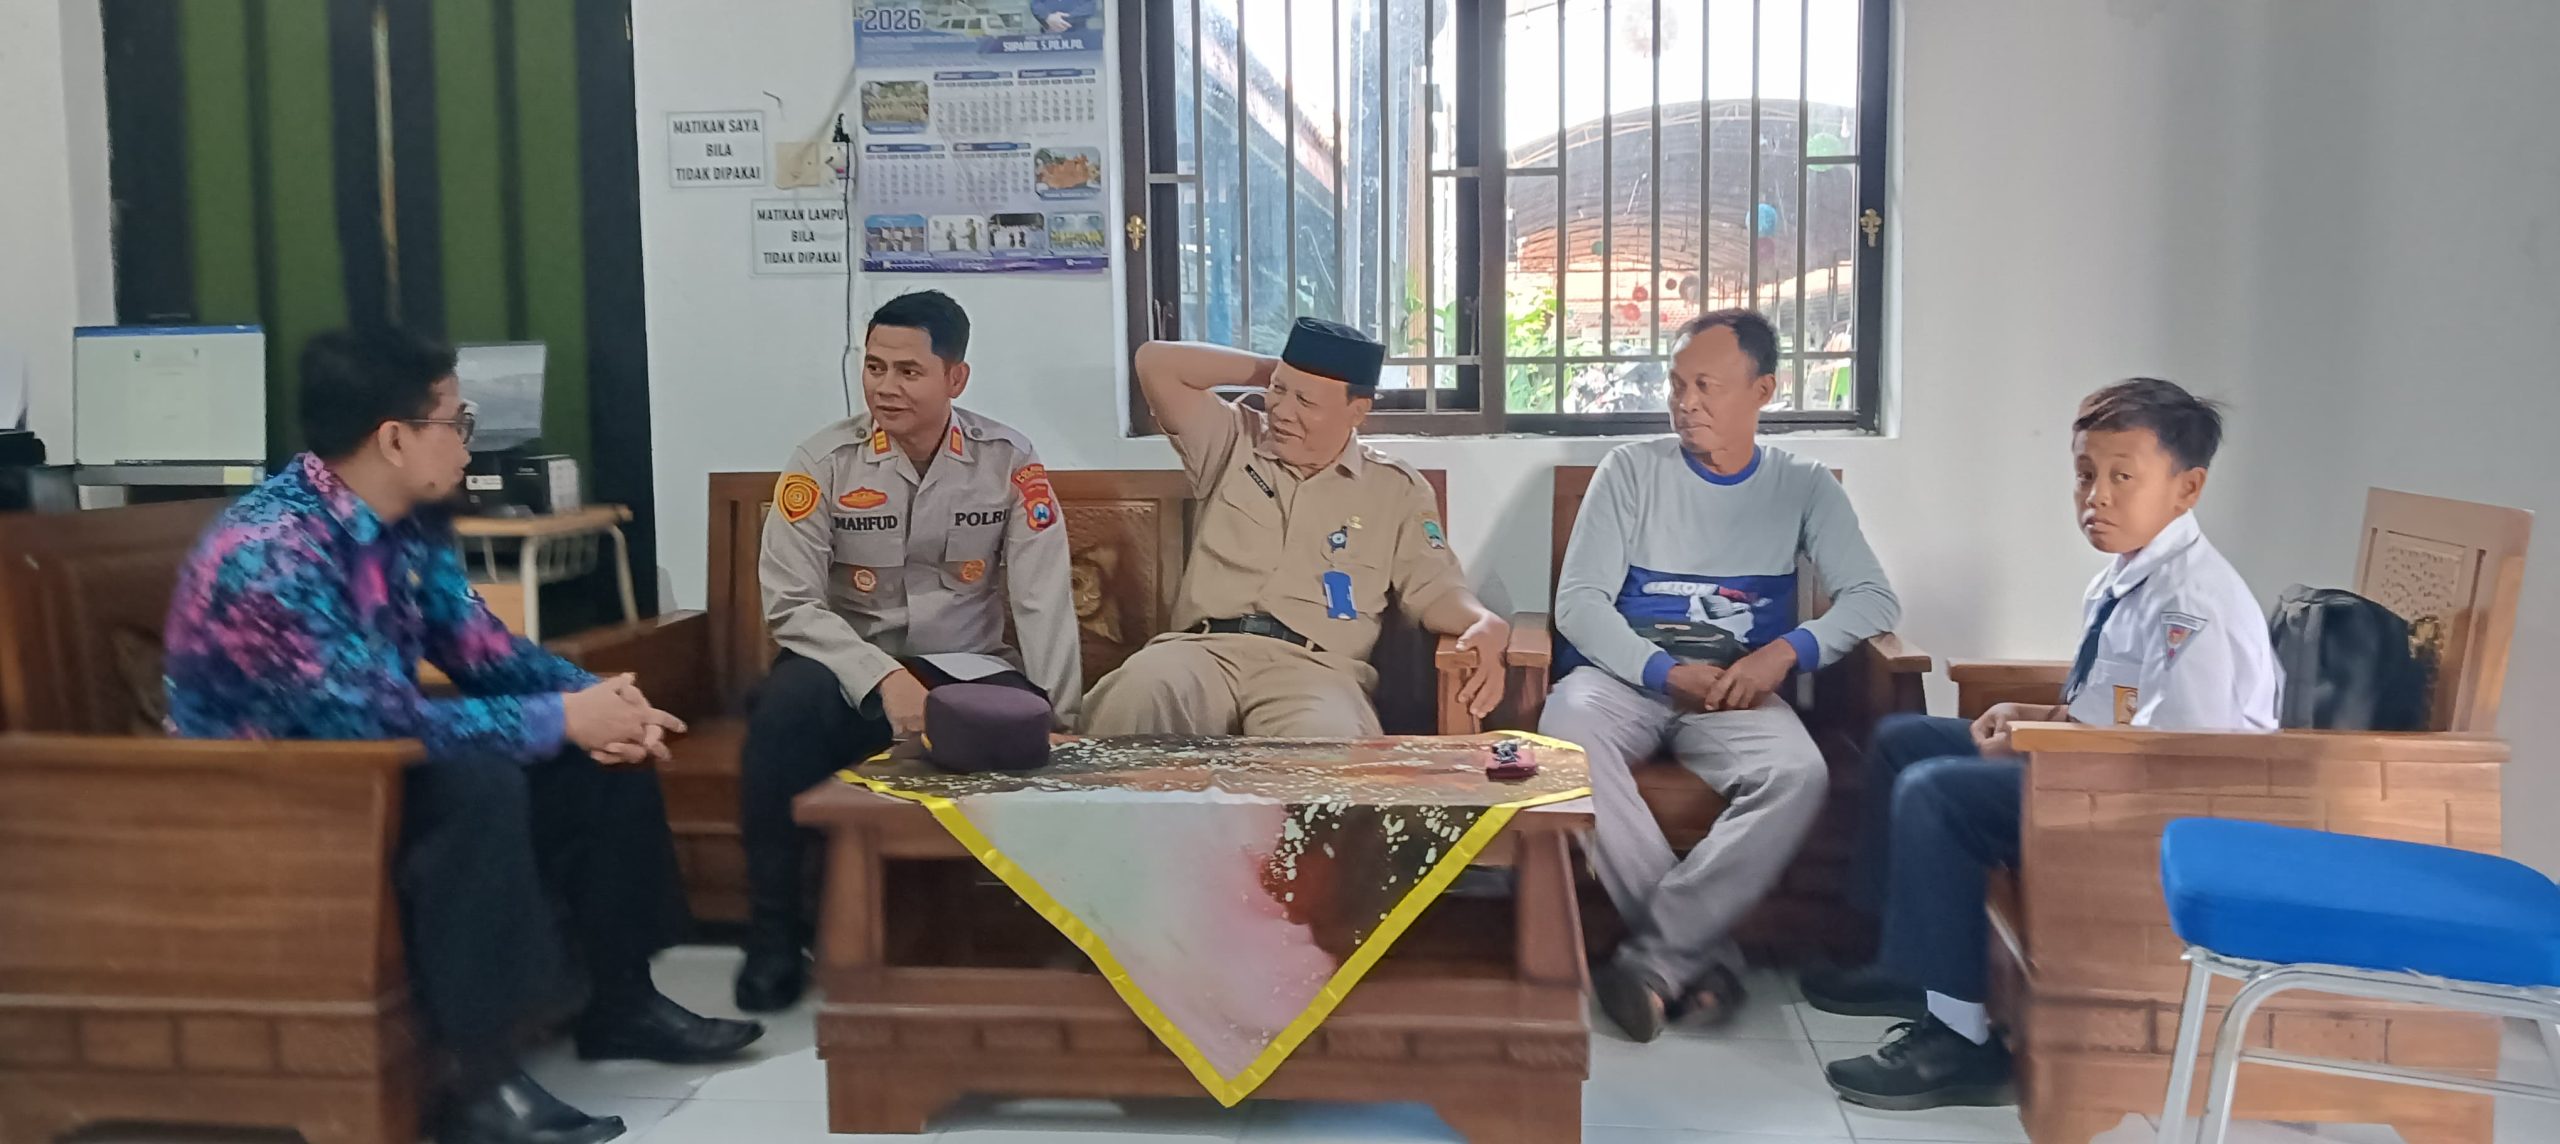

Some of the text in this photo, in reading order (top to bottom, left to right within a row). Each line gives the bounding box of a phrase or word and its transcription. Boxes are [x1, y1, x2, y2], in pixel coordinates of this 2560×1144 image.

[863, 9, 922, 32] 2026
[673, 118, 760, 134] MATIKAN SAYA
[706, 144, 733, 157] BILA
[675, 166, 761, 181] TIDAK DIPAKAI
[757, 208, 844, 221] MATIKAN LAMPU
[791, 231, 815, 242] BILA
[763, 252, 842, 264] TIDAK DIPAKAI
[835, 515, 898, 531] MAHFUD
[954, 509, 1007, 526] POLRI
